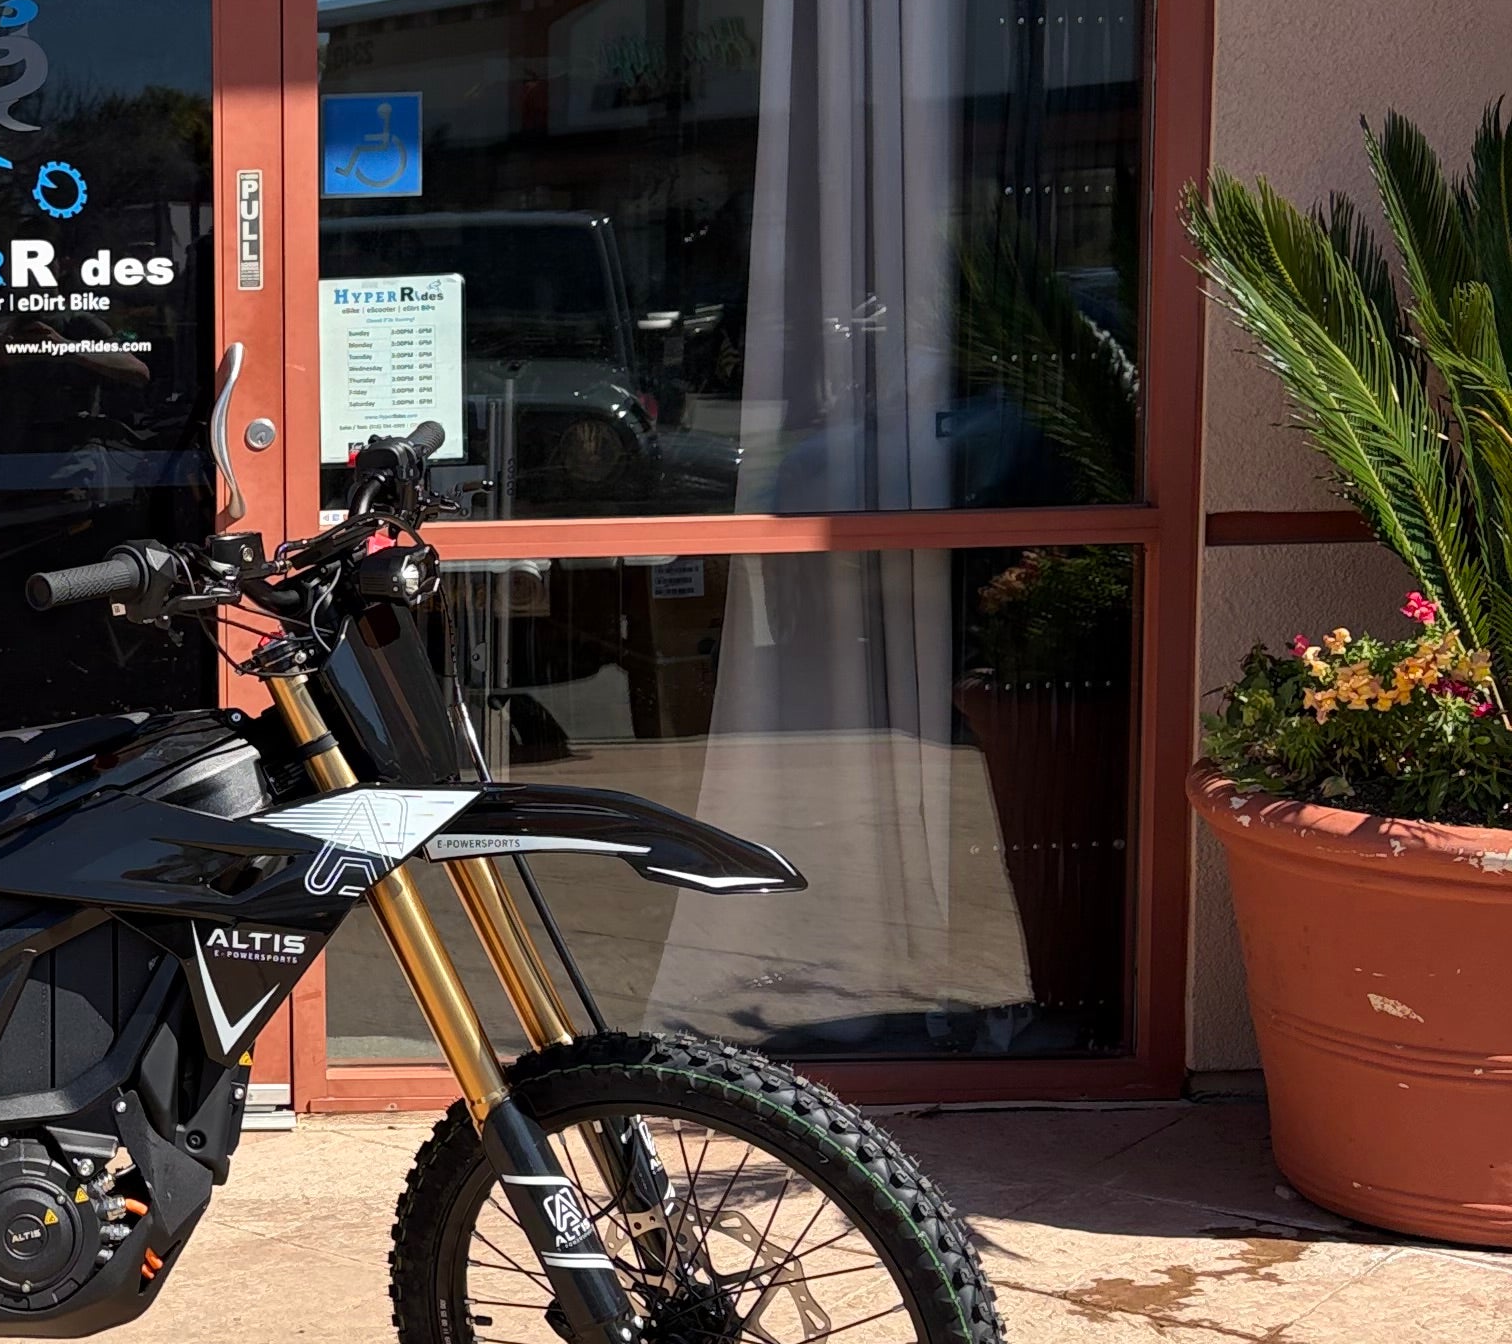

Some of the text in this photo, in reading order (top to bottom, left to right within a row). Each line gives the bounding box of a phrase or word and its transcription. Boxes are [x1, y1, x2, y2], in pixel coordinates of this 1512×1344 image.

[240, 179, 259, 261] PULL
[17, 294, 65, 312] eDirt
[69, 292, 111, 311] Bike
[5, 340, 152, 355] www.HyperRides.com
[437, 838, 521, 849] E-POWERSPORTS
[206, 928, 306, 954] ALTIS
[11, 1228, 42, 1243] ALTIS
[555, 1217, 592, 1248] ALTIS
